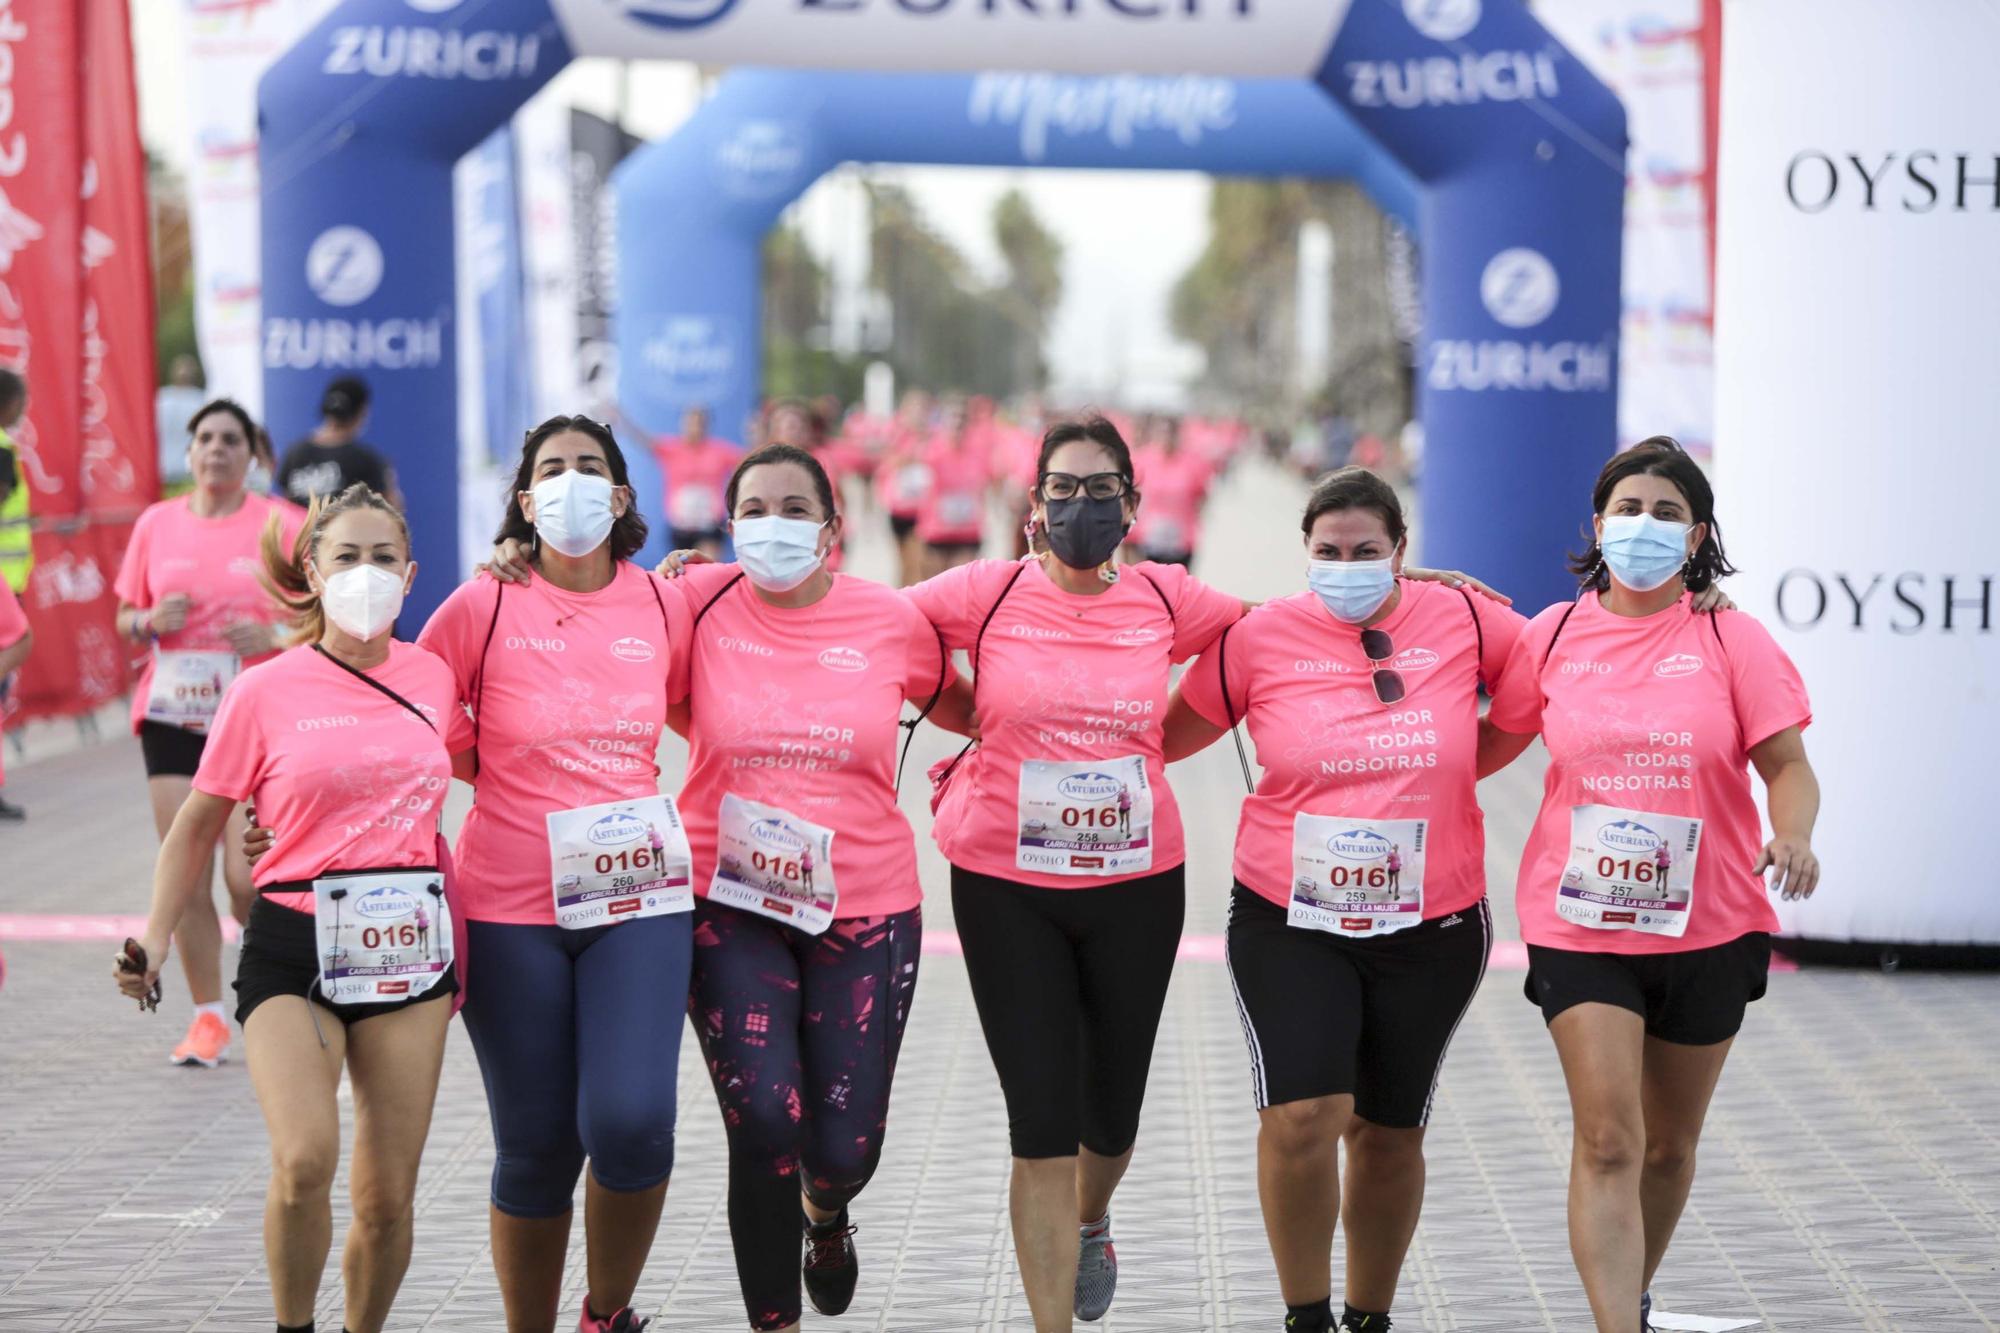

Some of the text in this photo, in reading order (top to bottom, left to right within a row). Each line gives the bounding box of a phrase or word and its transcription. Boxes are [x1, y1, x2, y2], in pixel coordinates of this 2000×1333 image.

[322, 25, 541, 80] ZURICH
[1346, 52, 1560, 108] ZURICH
[263, 318, 442, 369] ZURICH
[1428, 340, 1611, 391] ZURICH
[505, 636, 566, 652] OYSHO
[719, 636, 774, 656] OYSHO
[1114, 700, 1153, 714] POR
[297, 715, 358, 732] OYSHO
[1391, 710, 1433, 726] POR
[615, 720, 655, 735] POR
[809, 725, 855, 744] POR
[1366, 730, 1437, 750] TODAS
[1649, 732, 1693, 747] POR
[1321, 753, 1437, 774] NOSOTRAS
[1623, 753, 1692, 768] TODAS
[1062, 782, 1118, 794] ASTURIANA
[1582, 775, 1692, 791] NOSOTRAS
[1061, 807, 1117, 828] 016
[592, 824, 644, 841] ASTURIANA
[1077, 832, 1099, 843] 258
[1602, 830, 1657, 848] ASTURIANA
[1044, 840, 1080, 850] CARRERA
[1105, 841, 1131, 851] MUJER
[1332, 840, 1388, 853] ASTURIANA
[595, 847, 651, 874] 016
[752, 850, 800, 881] 016
[1022, 852, 1065, 866] OYSHO
[1330, 866, 1386, 888] 016
[1597, 855, 1654, 883] 016
[613, 875, 634, 888] 260
[580, 880, 668, 901] CARRERA DE LA MUJER
[1345, 891, 1366, 902] 259
[1611, 885, 1633, 897] 257
[1315, 900, 1349, 911] CARRERA
[1373, 903, 1400, 912] MUJER
[1579, 891, 1667, 909] CARRERA DE LA MUJER
[562, 906, 604, 923] OYSHO
[1293, 908, 1336, 926] OYSHO
[1559, 903, 1597, 920] OYSHO
[362, 925, 415, 949] 016
[348, 966, 385, 976] CARRERA
[328, 983, 372, 996] OYSHO
